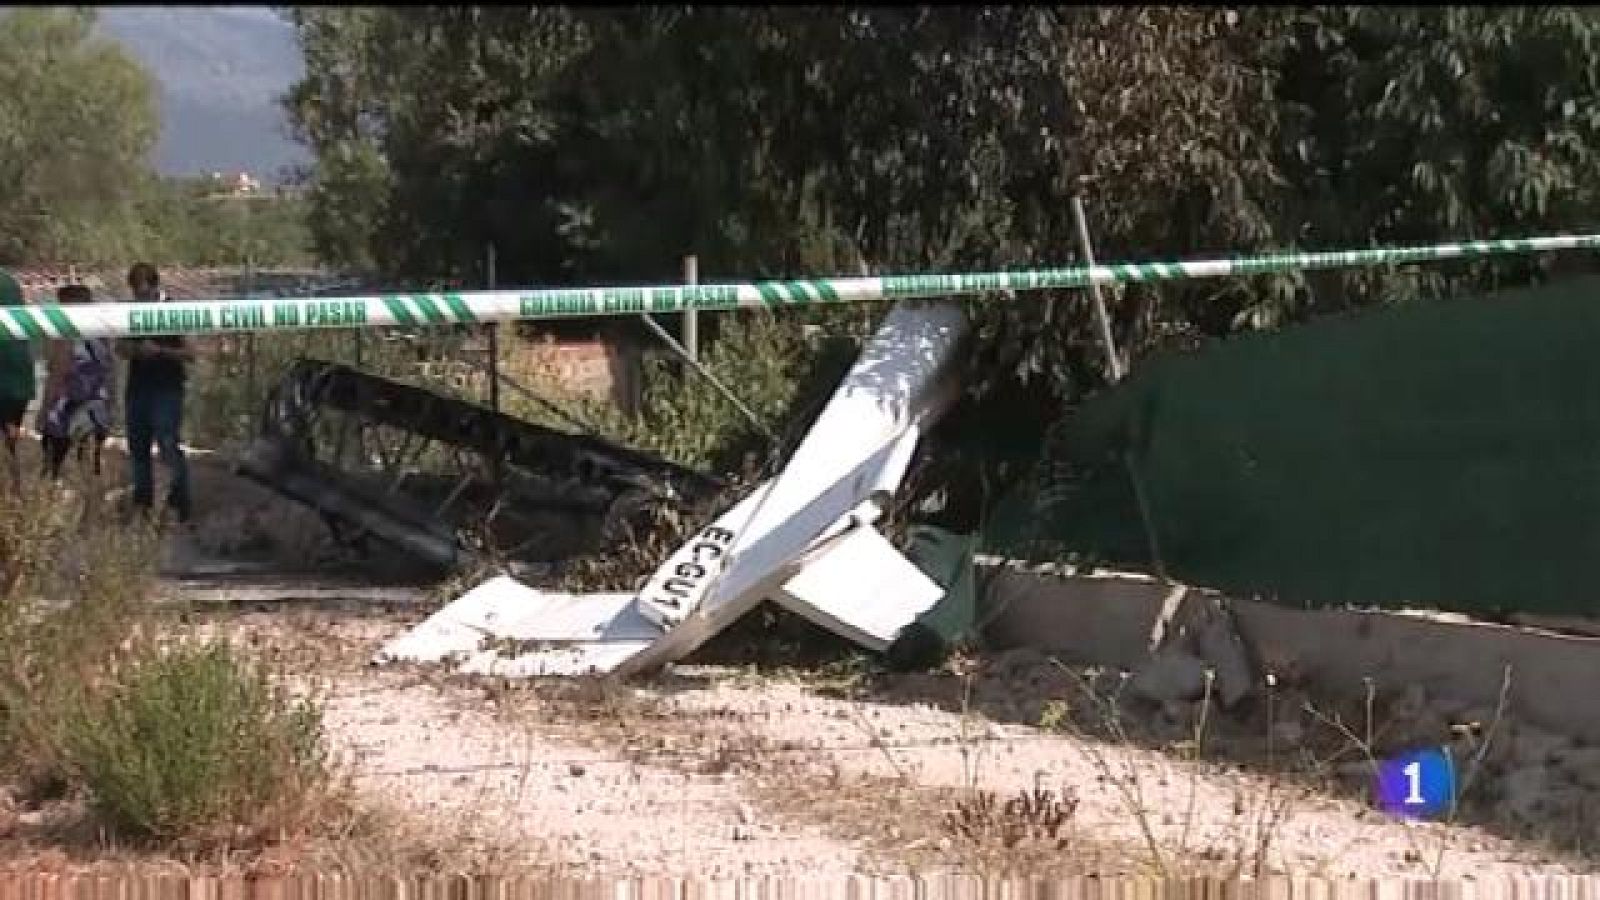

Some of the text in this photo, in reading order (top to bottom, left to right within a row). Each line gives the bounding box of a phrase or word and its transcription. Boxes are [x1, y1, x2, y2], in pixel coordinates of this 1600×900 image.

[129, 300, 367, 333] GUARDIA CIVIL NO PASAR
[520, 286, 738, 316] GUARDIA CIVIL NO PASAR
